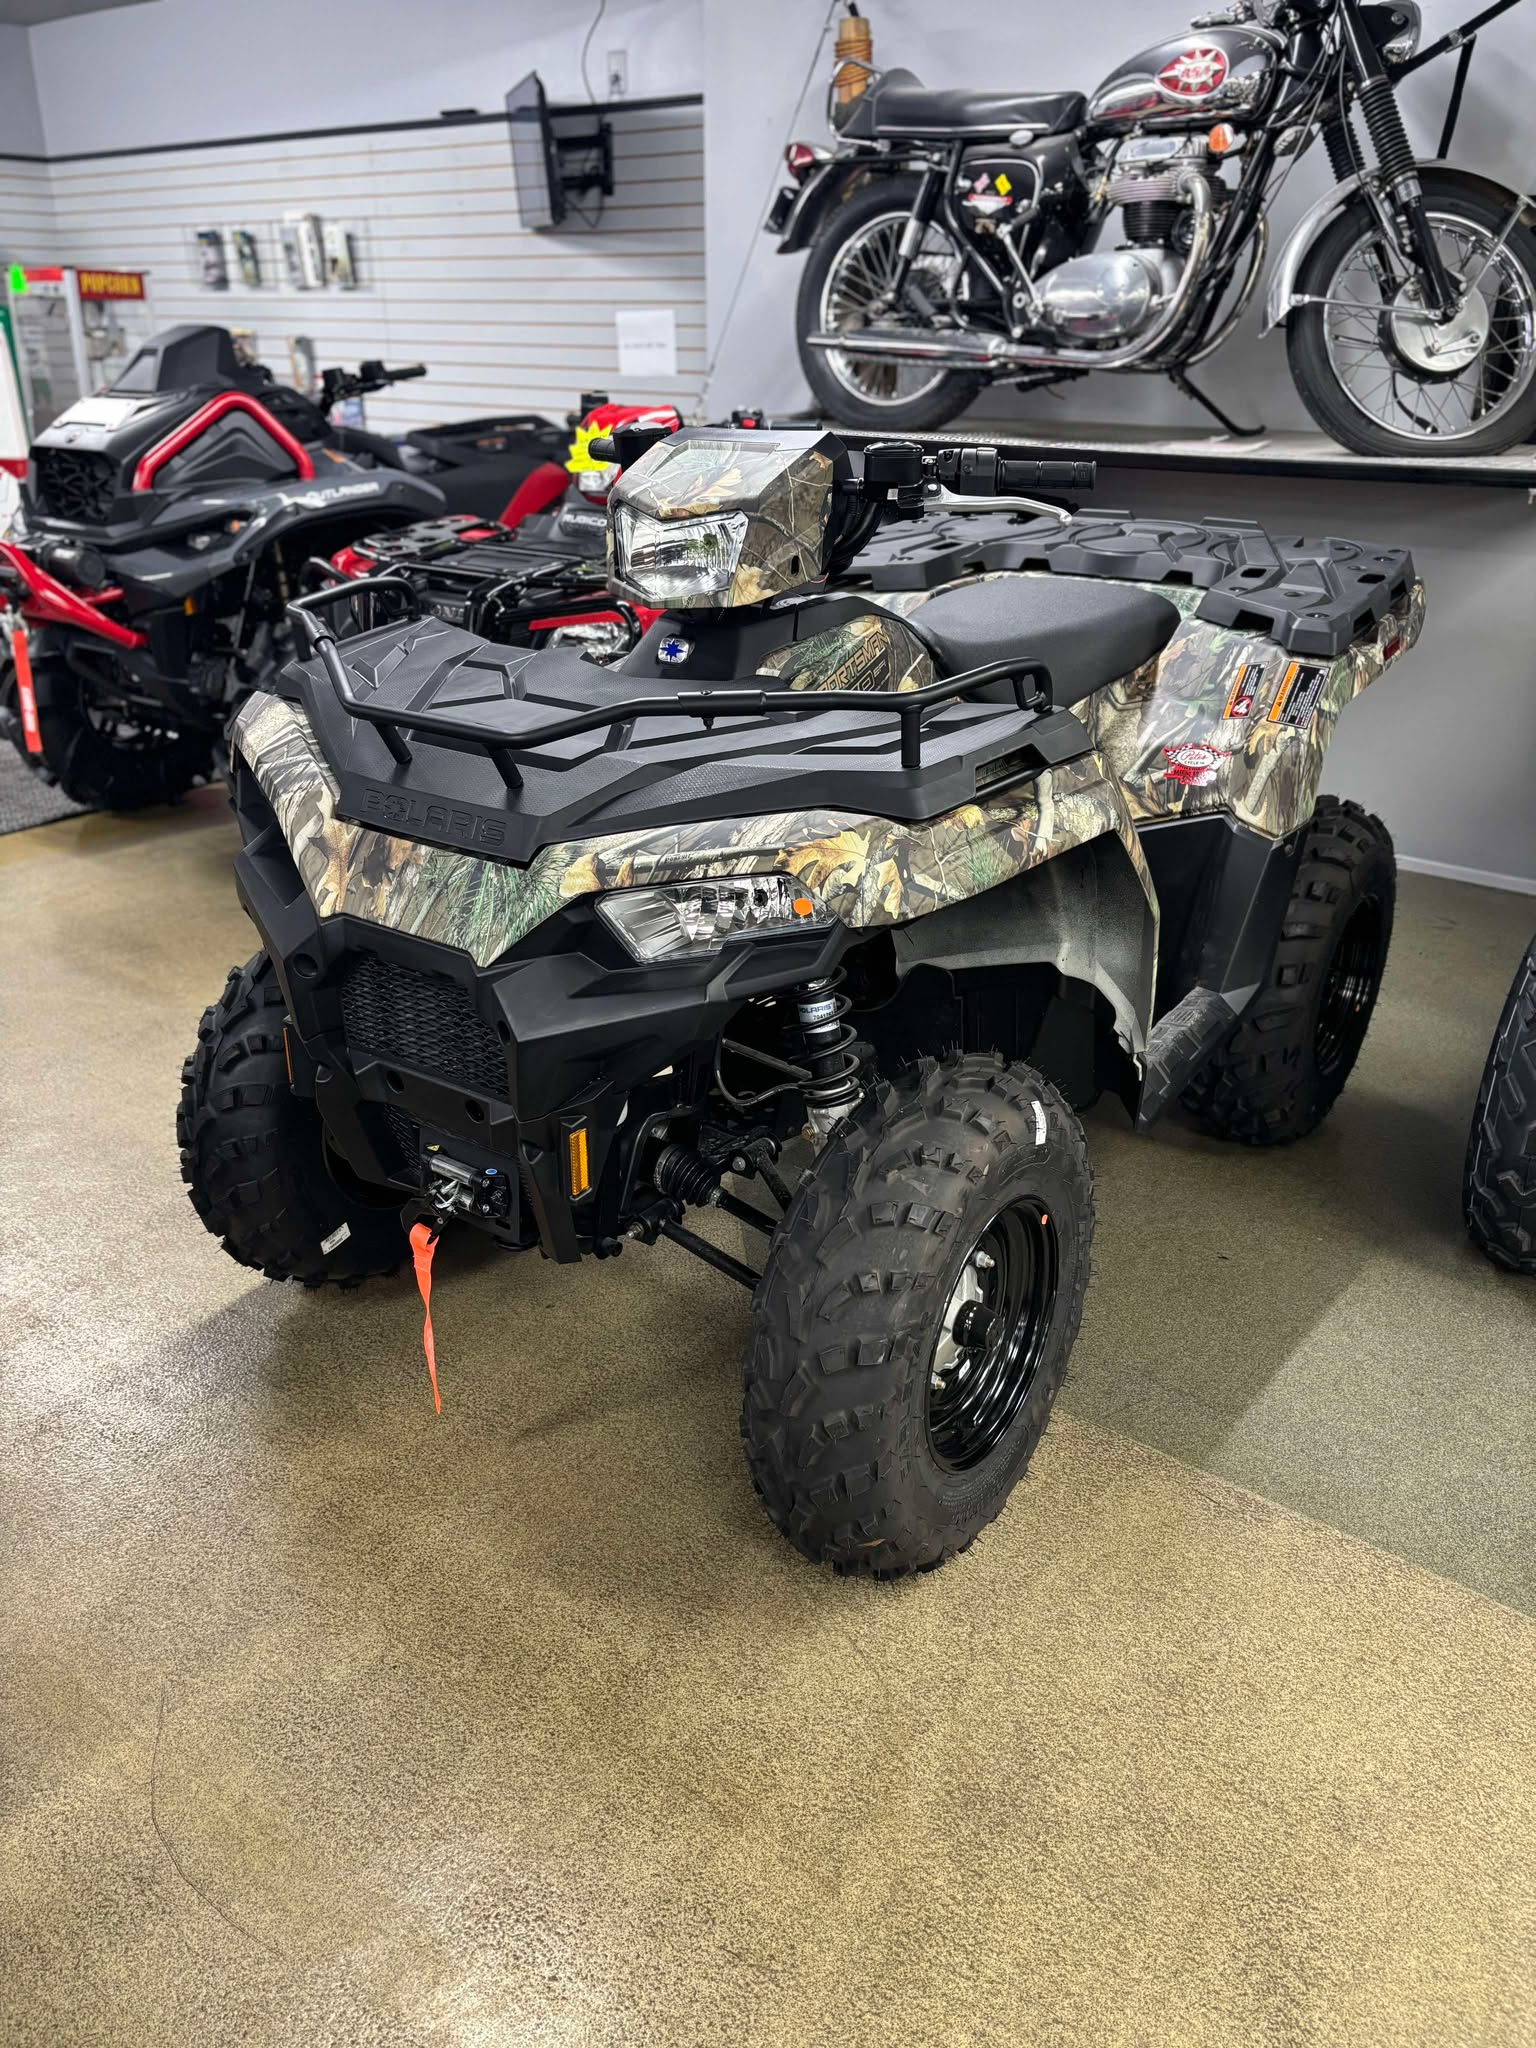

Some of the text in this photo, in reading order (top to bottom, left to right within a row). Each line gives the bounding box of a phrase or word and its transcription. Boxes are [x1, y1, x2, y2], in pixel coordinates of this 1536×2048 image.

[80, 271, 141, 295] POPCORN
[562, 514, 608, 527] RUBICO
[816, 627, 889, 691] PORTSMAN
[360, 788, 508, 847] POLARIS
